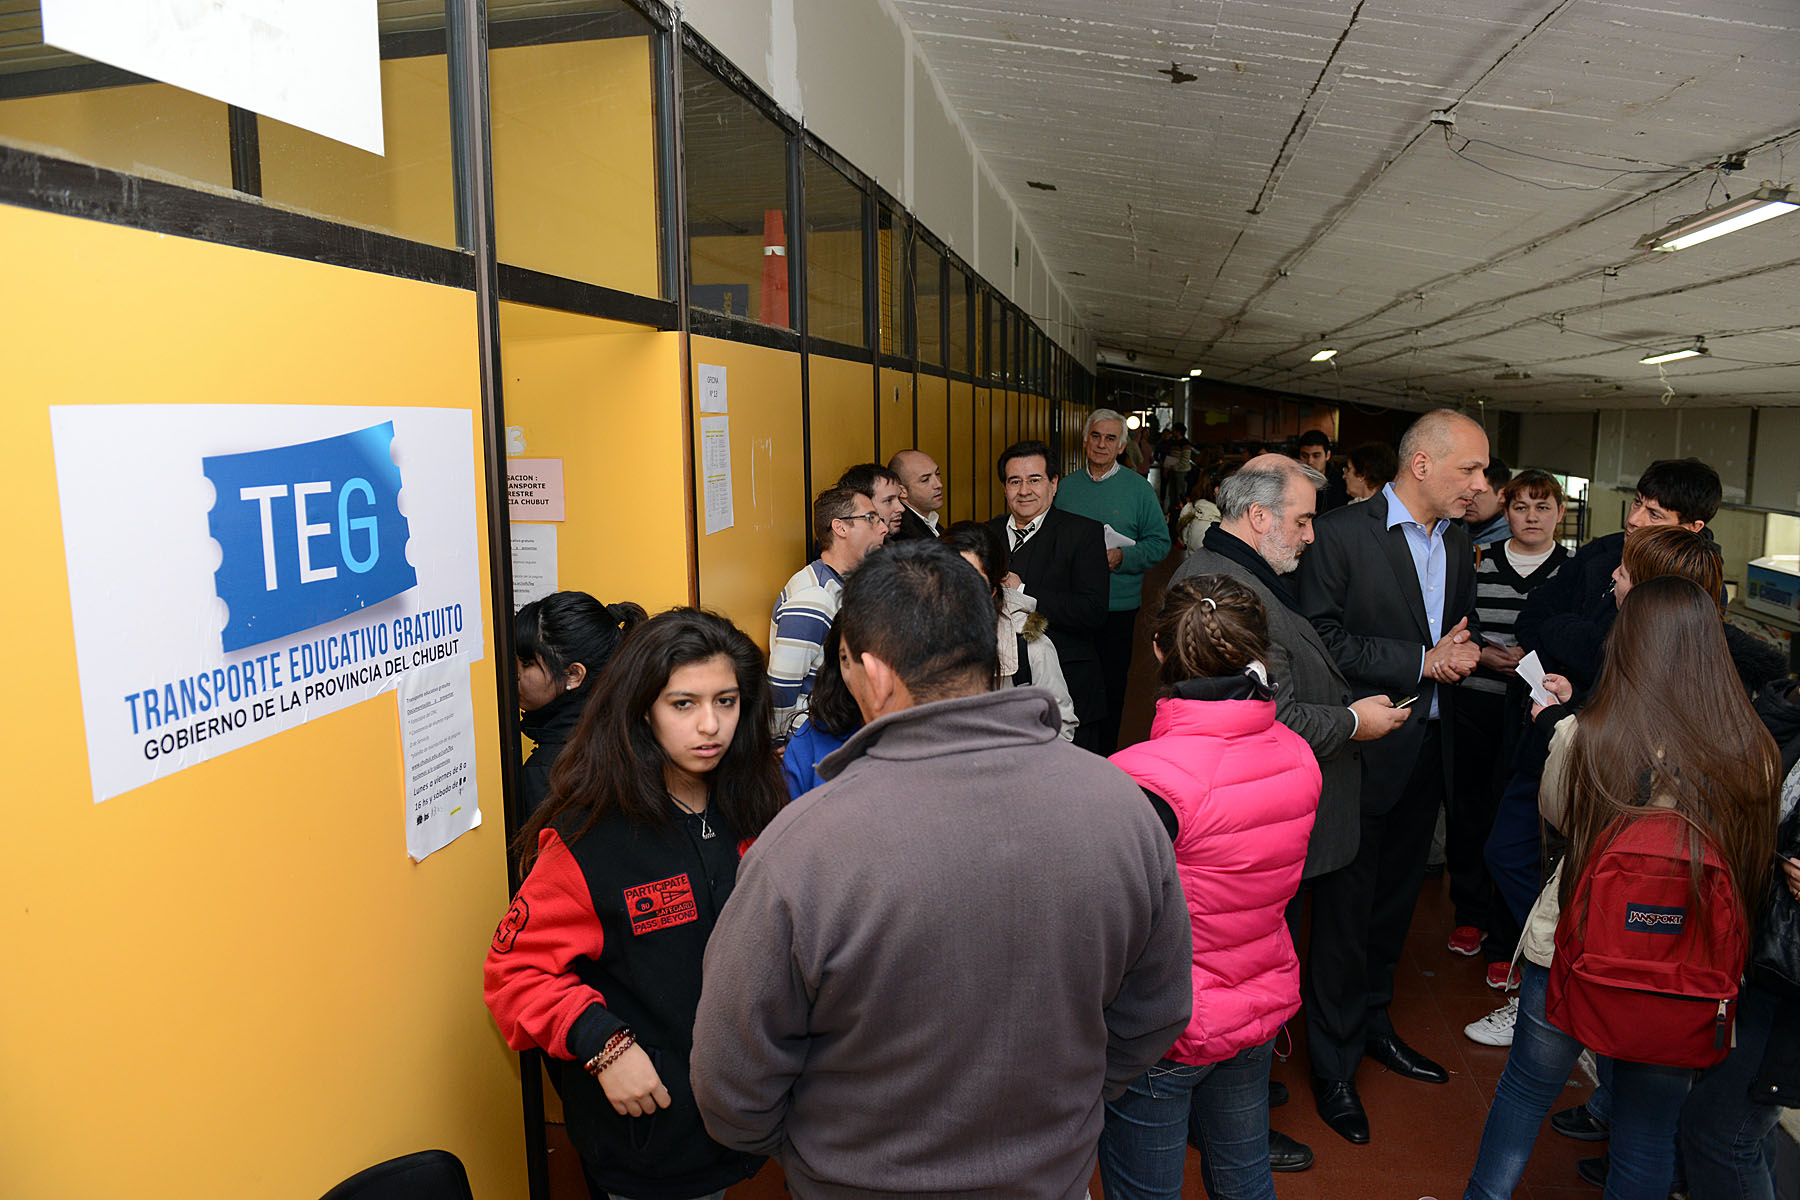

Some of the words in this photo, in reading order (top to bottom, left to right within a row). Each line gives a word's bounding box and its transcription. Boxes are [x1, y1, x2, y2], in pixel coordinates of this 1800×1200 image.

[240, 477, 380, 592] TEG
[124, 651, 283, 735] TRANSPORTE
[289, 622, 388, 683] EDUCATIVO
[393, 603, 463, 651] GRATUITO
[144, 708, 247, 760] GOBIERNO
[252, 698, 276, 722] DE
[280, 691, 305, 713] LA
[305, 664, 382, 704] PROVINCIA
[385, 656, 409, 677] DEL
[412, 639, 459, 666] CHUBUT
[413, 782, 429, 796] Lunes
[434, 770, 452, 785] viernes
[415, 800, 422, 811] 16
[626, 875, 688, 900] PARTICIPATE
[635, 919, 658, 934] PASS
[661, 909, 696, 925] BEYOND
[1628, 911, 1683, 926] JANSPORT
